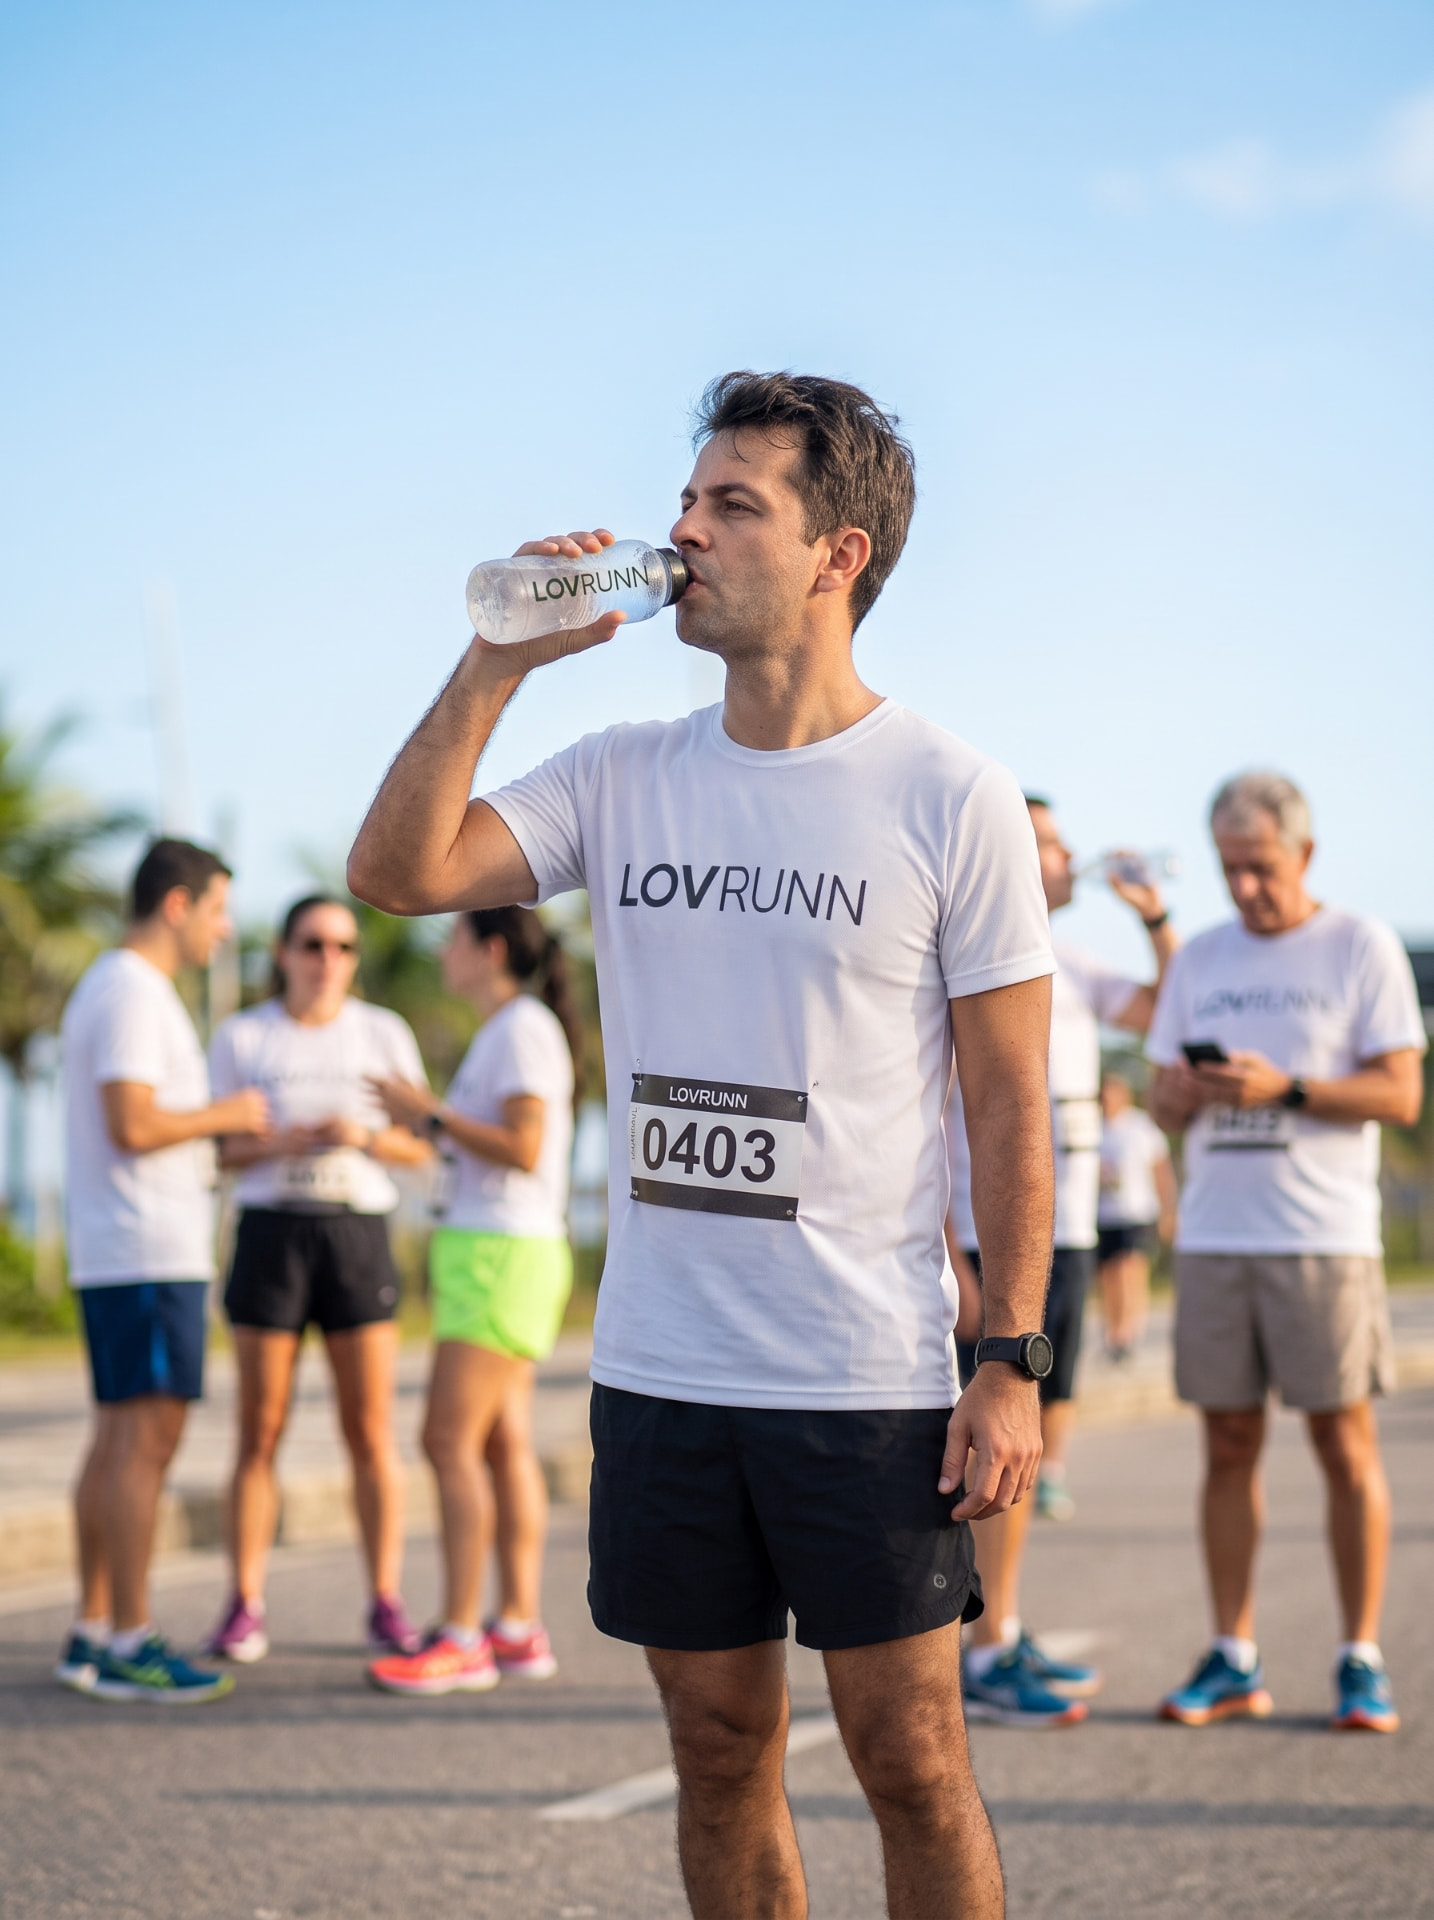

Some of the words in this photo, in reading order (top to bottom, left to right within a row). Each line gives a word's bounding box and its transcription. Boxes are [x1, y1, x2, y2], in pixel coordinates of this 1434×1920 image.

[532, 565, 649, 602] LOVRUNN
[619, 863, 866, 926] LOVRUNN
[669, 1086, 748, 1109] LOVRUNN
[642, 1118, 776, 1183] 0403
